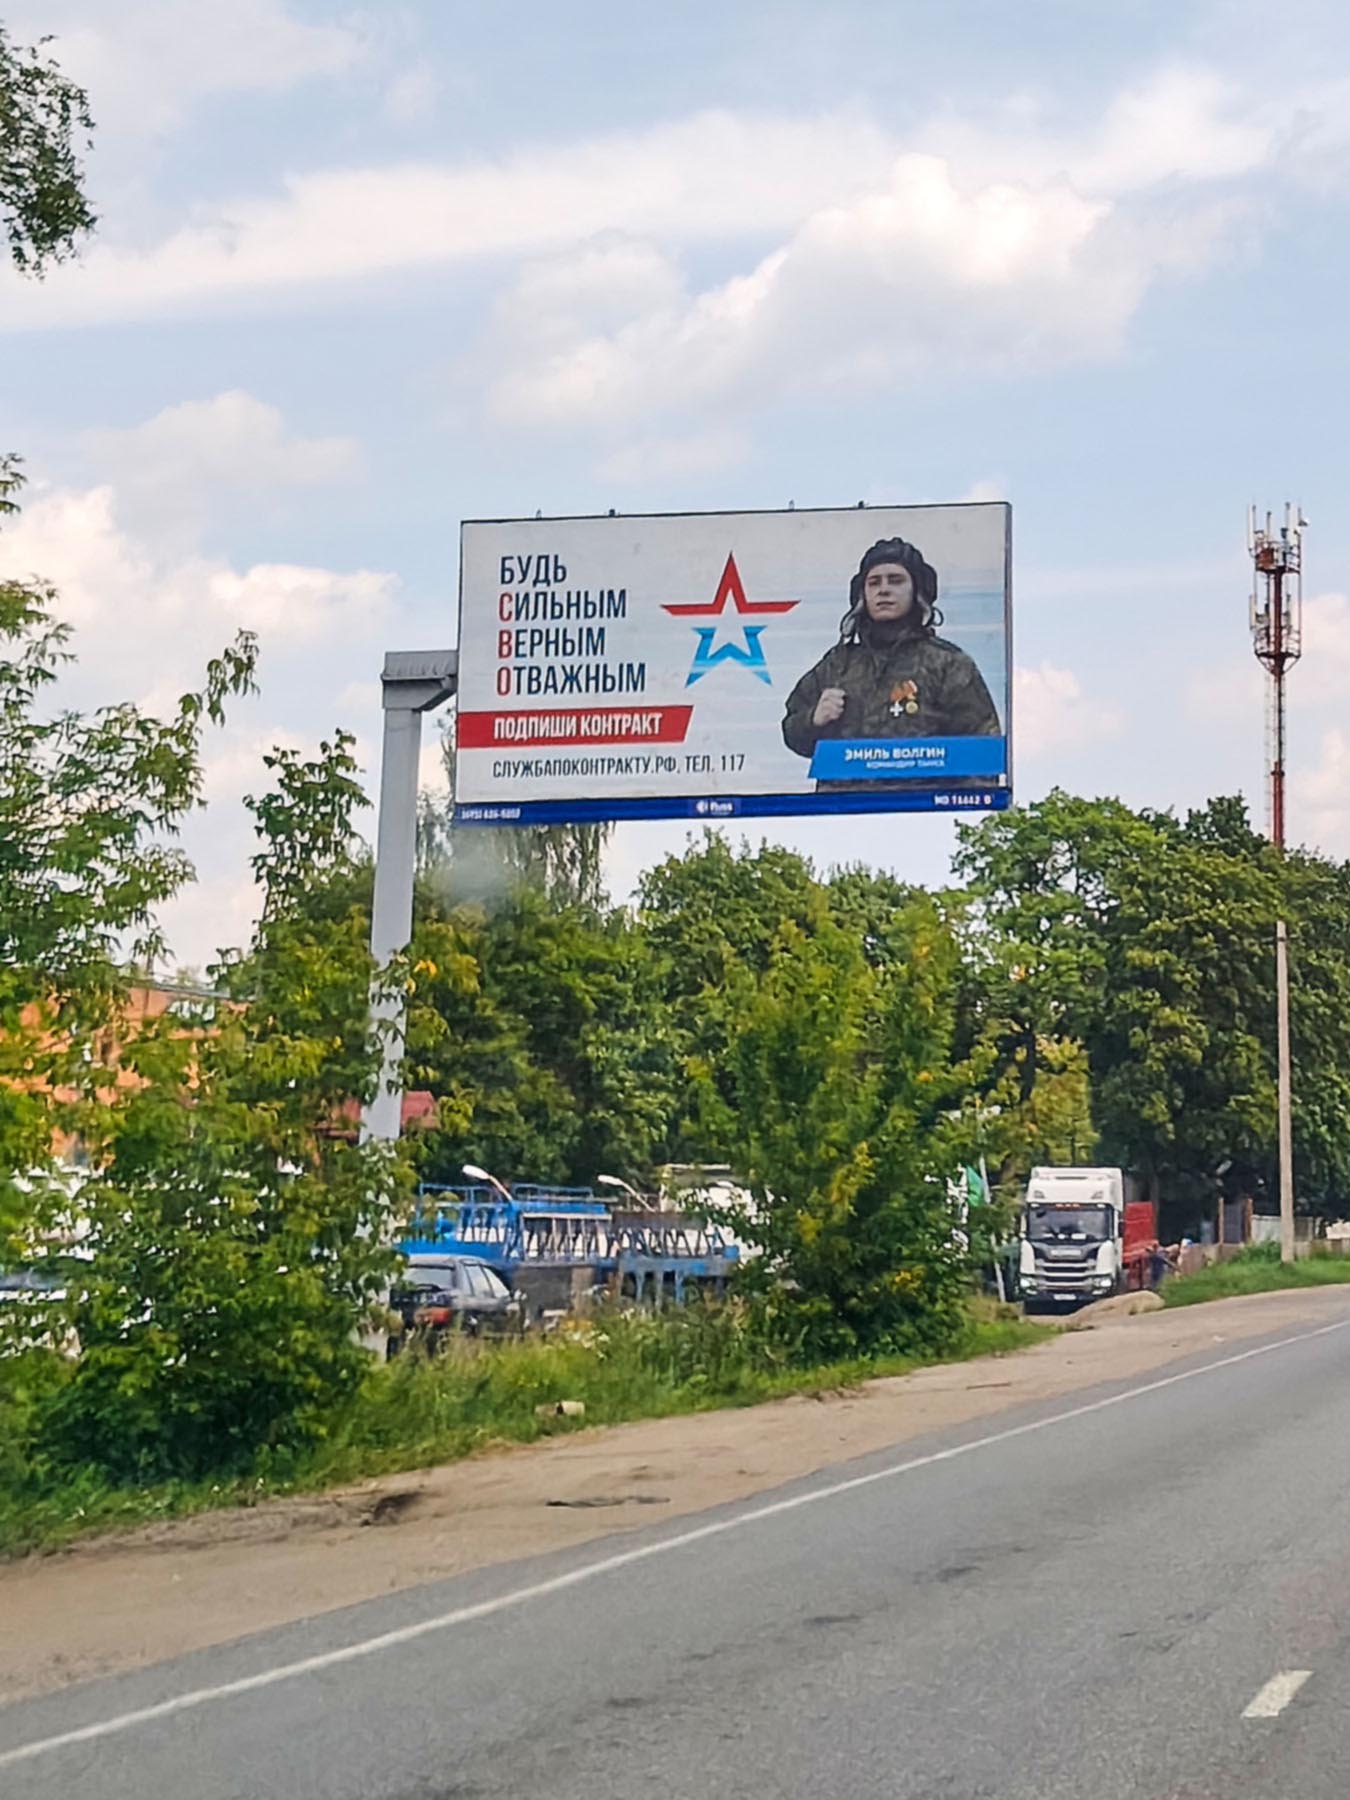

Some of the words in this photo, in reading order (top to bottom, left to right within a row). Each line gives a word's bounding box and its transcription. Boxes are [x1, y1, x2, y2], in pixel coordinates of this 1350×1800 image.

[500, 555, 567, 587] БУДЬ
[499, 589, 627, 622] СИЛЬНЫМ
[498, 627, 605, 659] ВЕРНЫМ
[497, 663, 646, 697] ОТВАЖНЫМ
[494, 715, 577, 741] ПОДПИШИ
[580, 713, 662, 737] КОНТРАКТ
[685, 755, 714, 774] ТЕЛ.
[721, 754, 745, 772] 117
